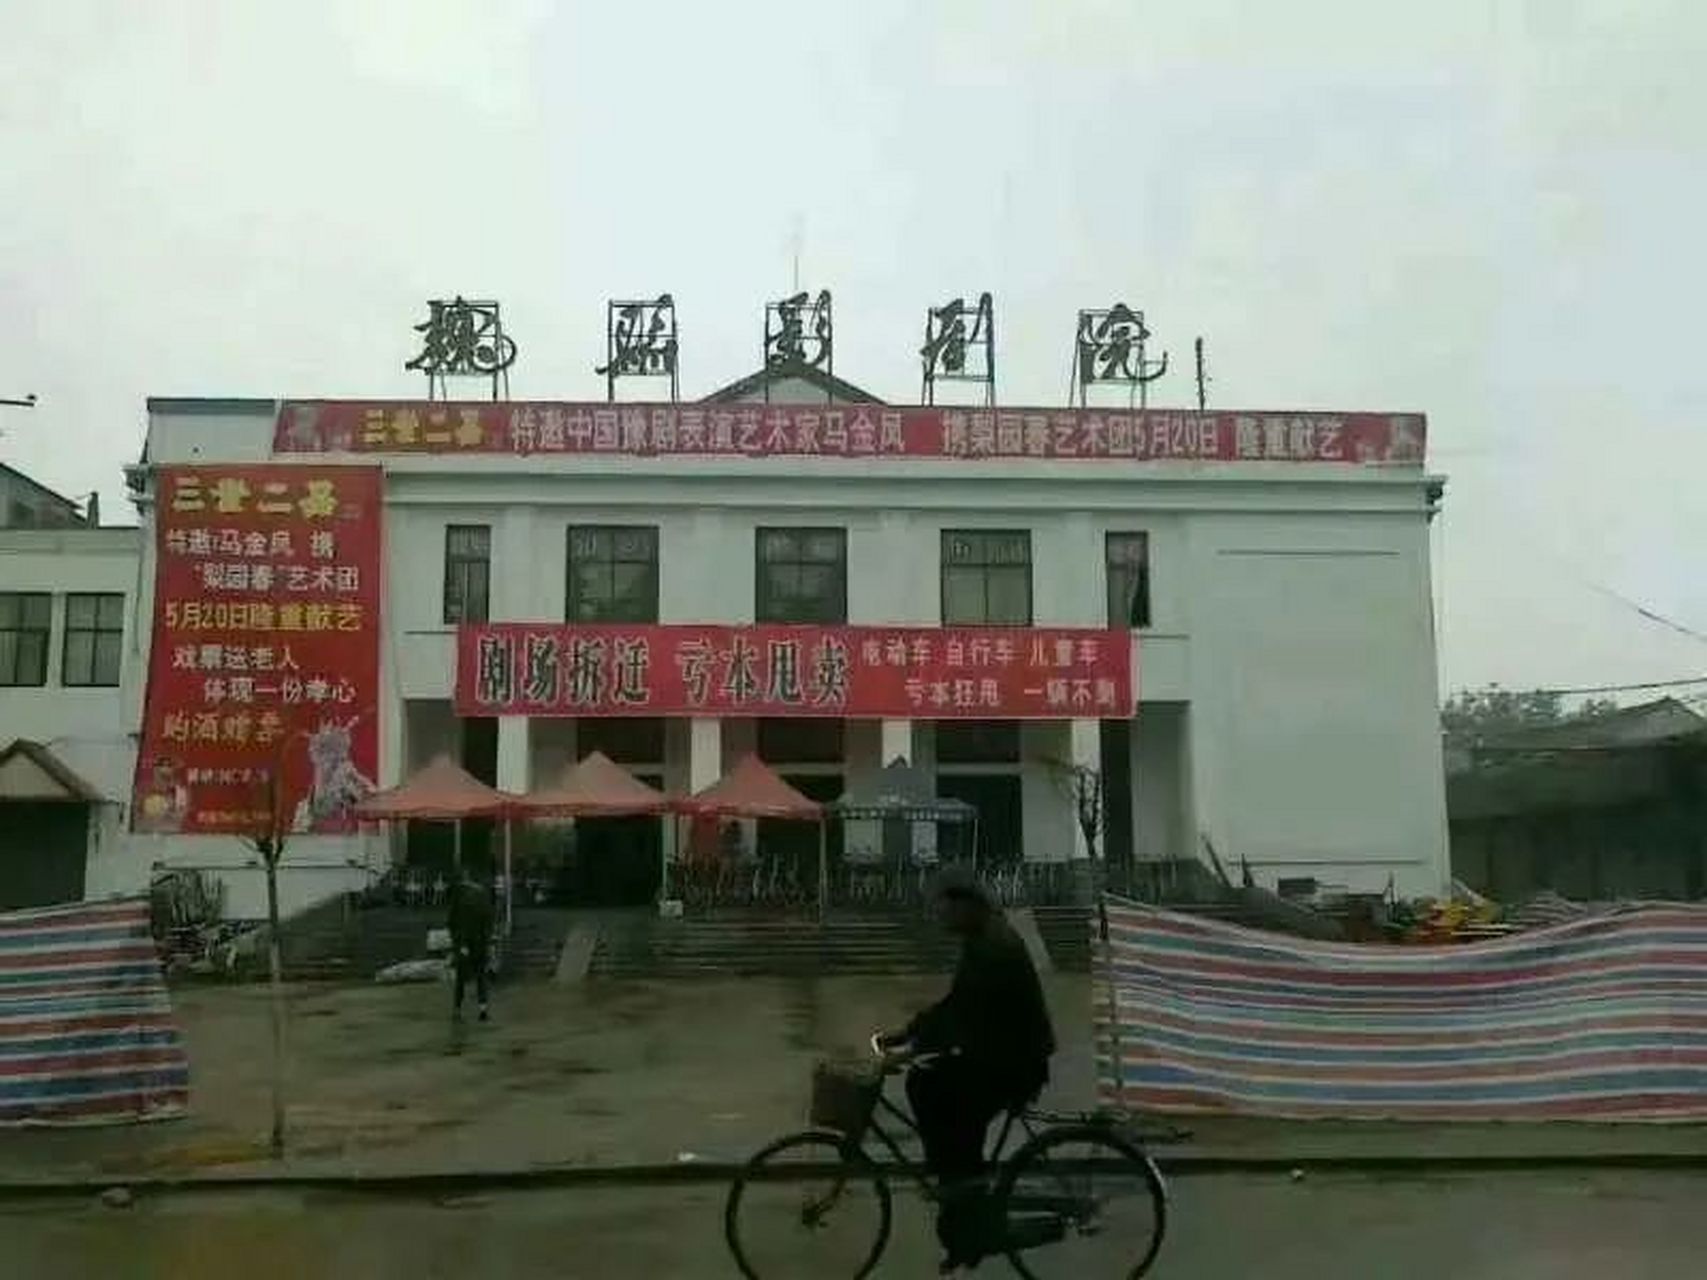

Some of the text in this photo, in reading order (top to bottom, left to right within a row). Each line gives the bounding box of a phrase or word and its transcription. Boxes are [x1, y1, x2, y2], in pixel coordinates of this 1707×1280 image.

[946, 637, 1019, 668] 自行车
[675, 634, 850, 706] 亏本甩卖
[903, 677, 1001, 709] 亏本狂甩
